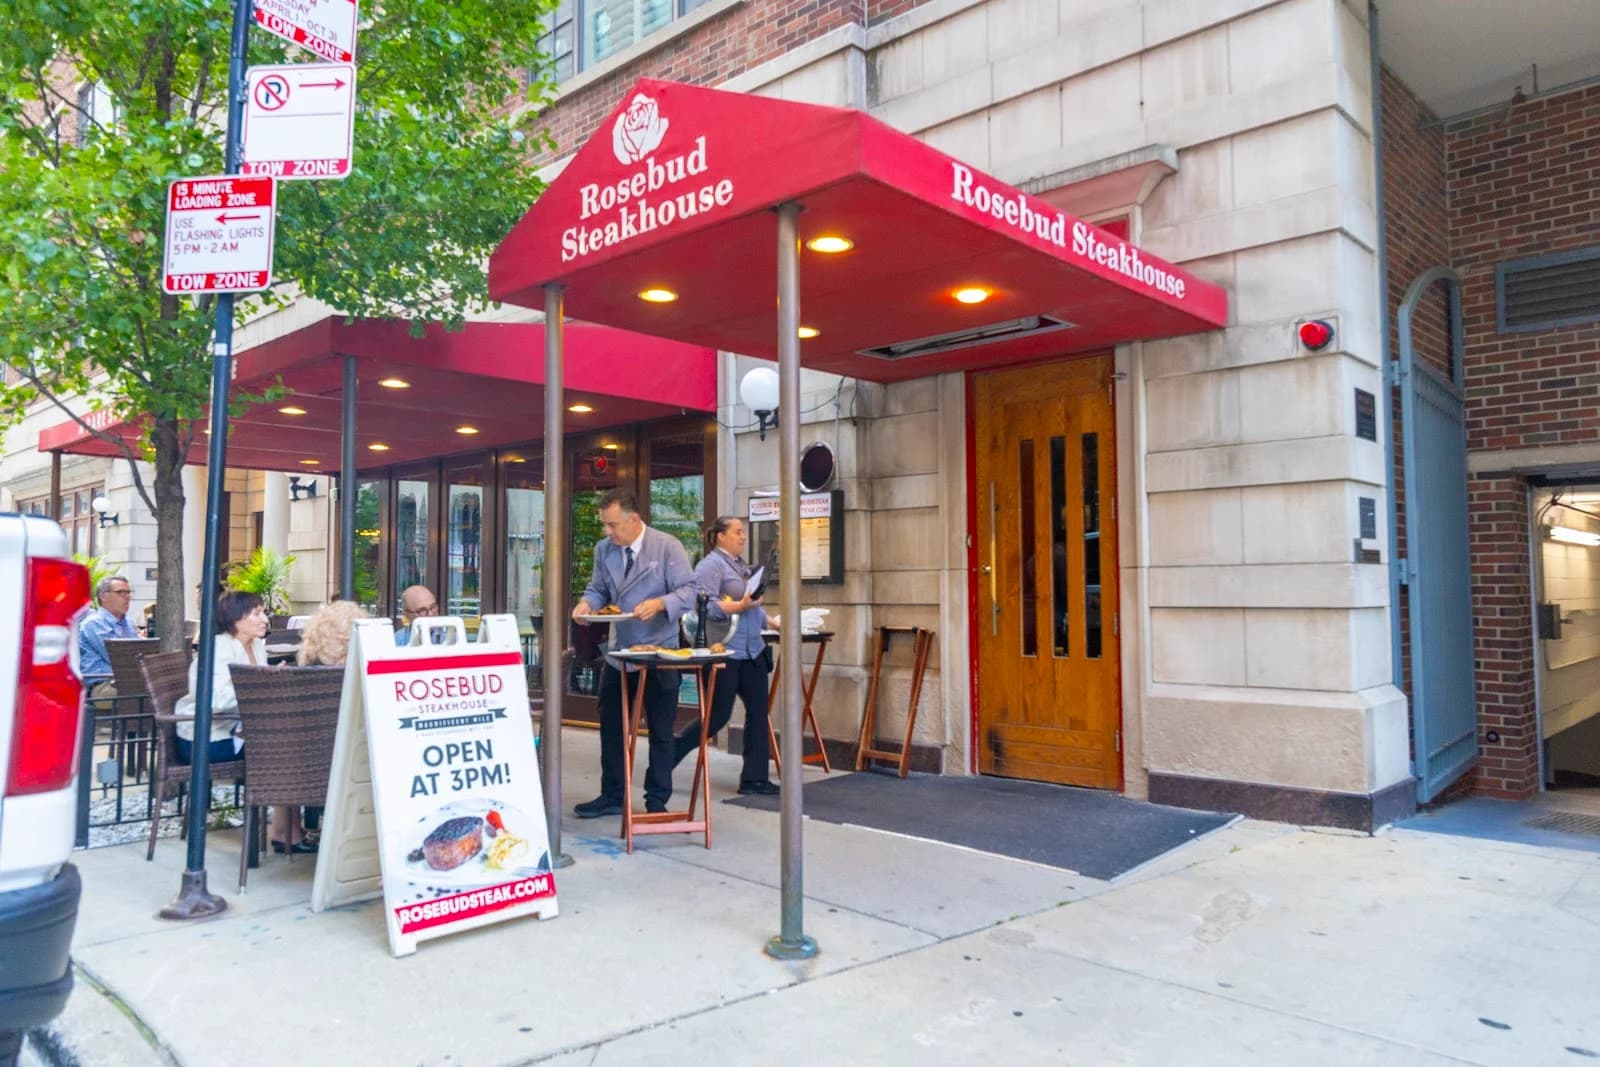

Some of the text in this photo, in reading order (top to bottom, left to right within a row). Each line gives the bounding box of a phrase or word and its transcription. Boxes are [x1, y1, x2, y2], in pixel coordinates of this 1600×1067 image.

[262, 11, 343, 62] TOW ZONE
[307, 20, 327, 35] OCT
[249, 160, 340, 176] TOW ZONE
[579, 135, 708, 221] Rosebud
[174, 192, 257, 209] LOADING ZONE
[176, 181, 234, 196] 15 MINUTE
[175, 217, 194, 229] USE
[561, 178, 734, 263] Steakhouse
[951, 161, 1185, 300] Rosebud Steakhouse
[174, 227, 265, 241] FLASHING LIGHTS
[171, 271, 260, 290] TOW ZONE
[395, 673, 503, 702] ROSEBUD
[418, 699, 489, 713] STEAKHOUSE
[422, 739, 493, 768] OPEN
[409, 763, 512, 798] AT 3PM!
[398, 876, 549, 927] ROSEBUDSTEAK.COM
